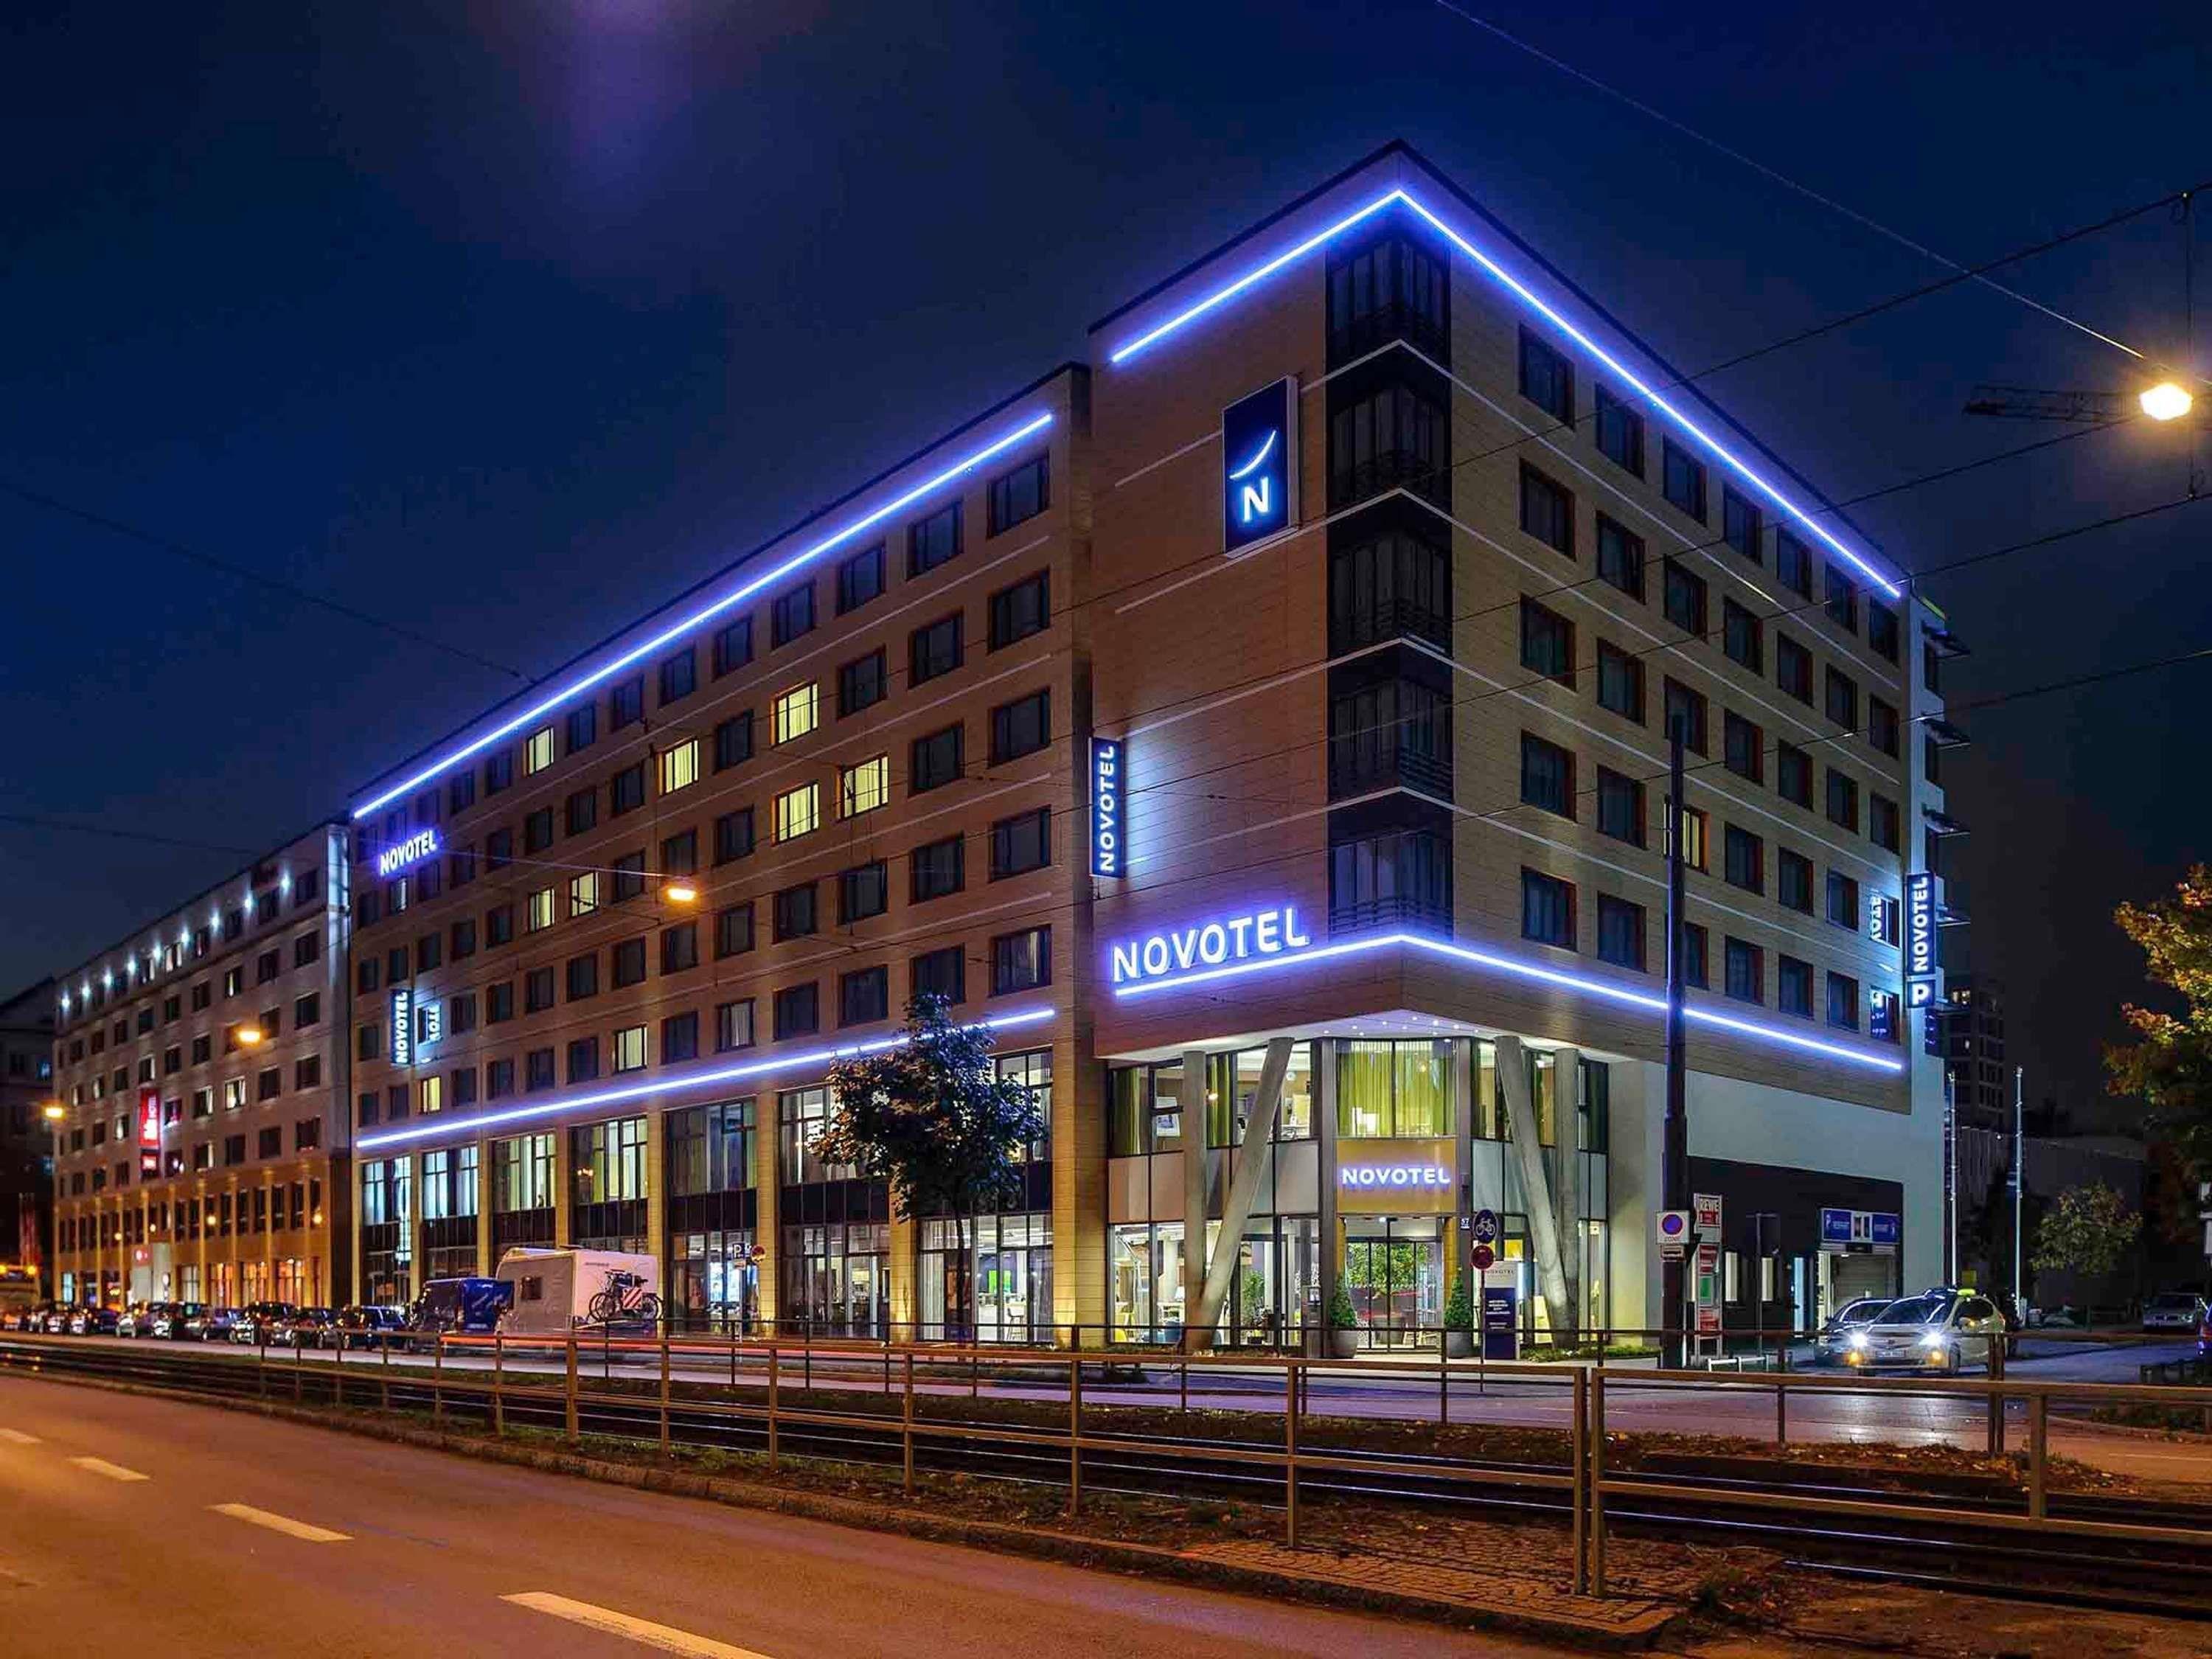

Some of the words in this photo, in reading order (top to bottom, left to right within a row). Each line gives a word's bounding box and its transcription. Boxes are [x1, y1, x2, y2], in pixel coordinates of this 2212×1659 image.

[1243, 476, 1269, 523] N
[1099, 745, 1116, 872] NOVOTEL
[380, 830, 437, 876] NOVOTEL
[1113, 907, 1310, 982] NOVOTEL
[1912, 877, 1928, 973] NOVOTEL
[1912, 983, 1930, 1006] P
[395, 991, 408, 1064] NOVOTEL
[1342, 1167, 1451, 1184] NOVOTEL
[733, 1244, 742, 1258] P
